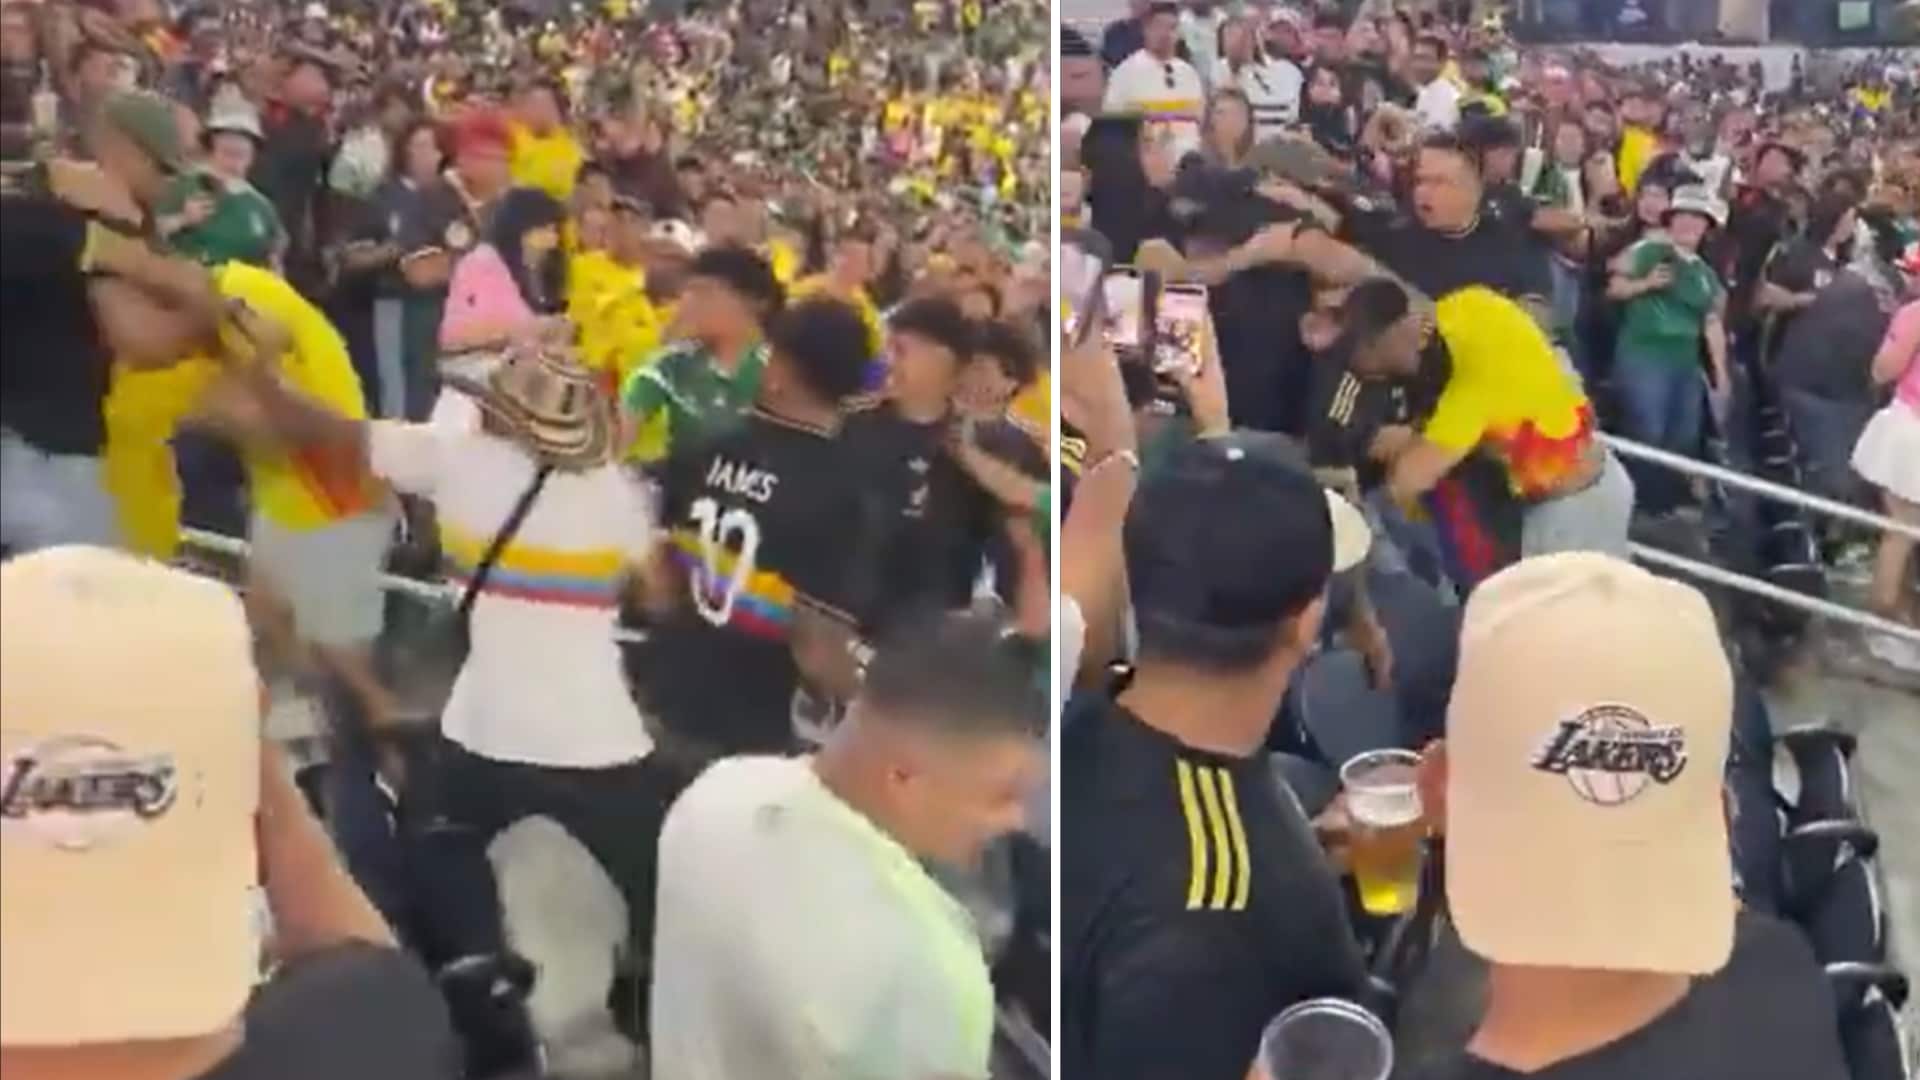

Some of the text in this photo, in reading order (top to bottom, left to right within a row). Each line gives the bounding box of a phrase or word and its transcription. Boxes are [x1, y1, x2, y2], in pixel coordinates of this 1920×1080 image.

[706, 453, 779, 502] JAMES
[690, 497, 761, 627] 10
[1532, 721, 1687, 784] LAKERS
